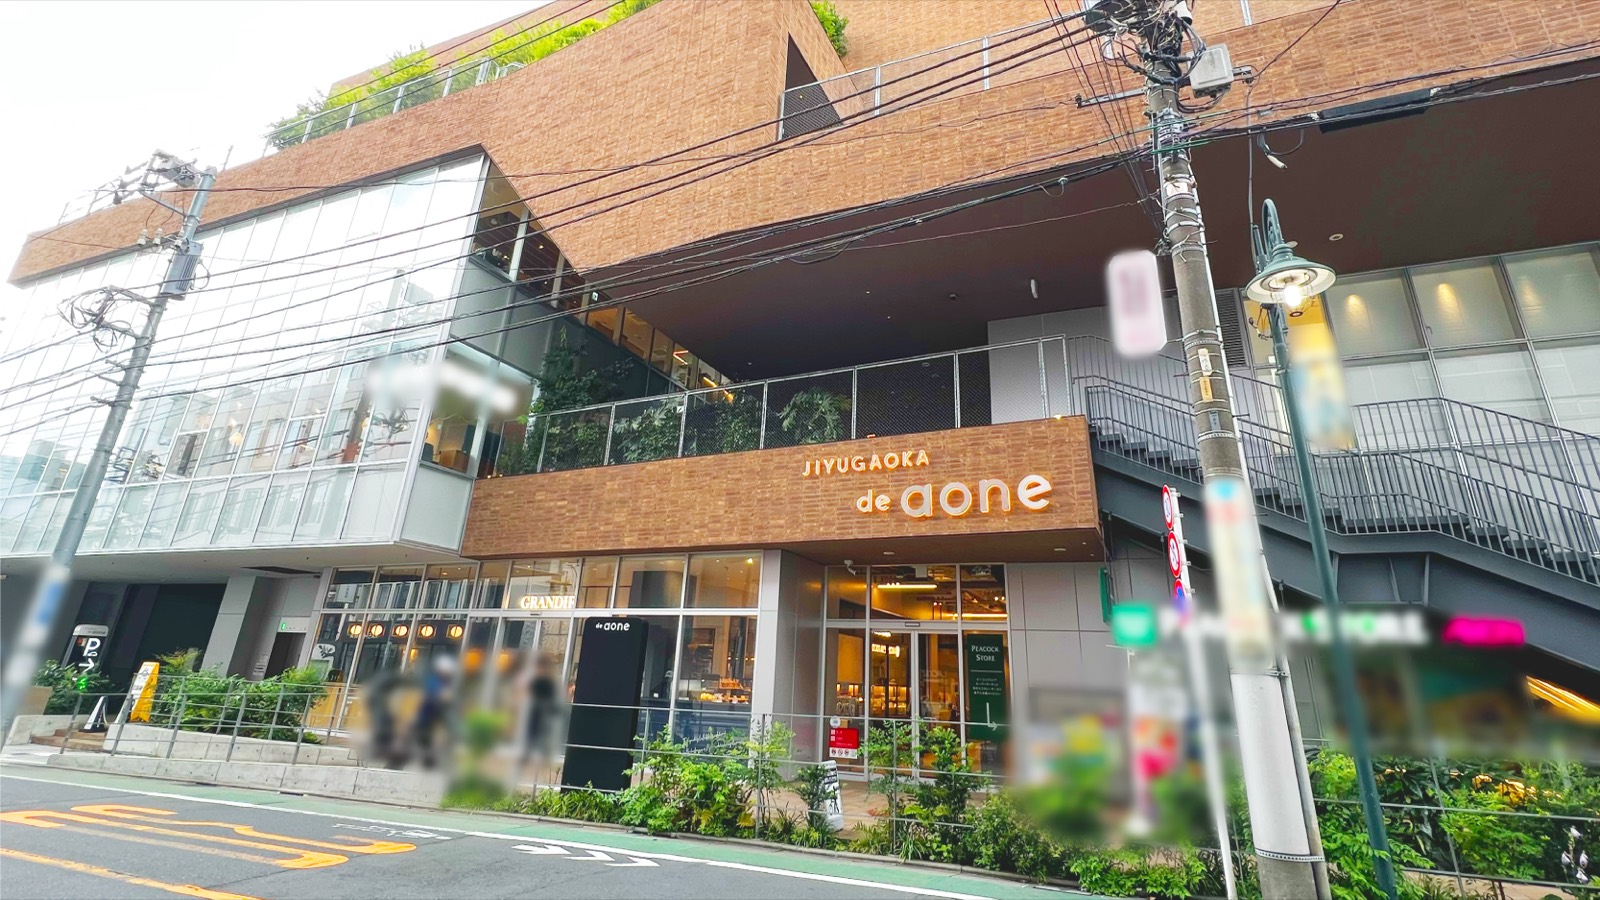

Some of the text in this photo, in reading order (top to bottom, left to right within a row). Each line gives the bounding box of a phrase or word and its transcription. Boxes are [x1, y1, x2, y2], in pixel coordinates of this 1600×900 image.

[802, 450, 930, 477] JIYUGAOKA
[856, 474, 1052, 518] de aone
[603, 622, 631, 631] aone
[82, 637, 101, 657] P
[971, 645, 1000, 653] PEACOCK
[975, 654, 996, 662] STORE
